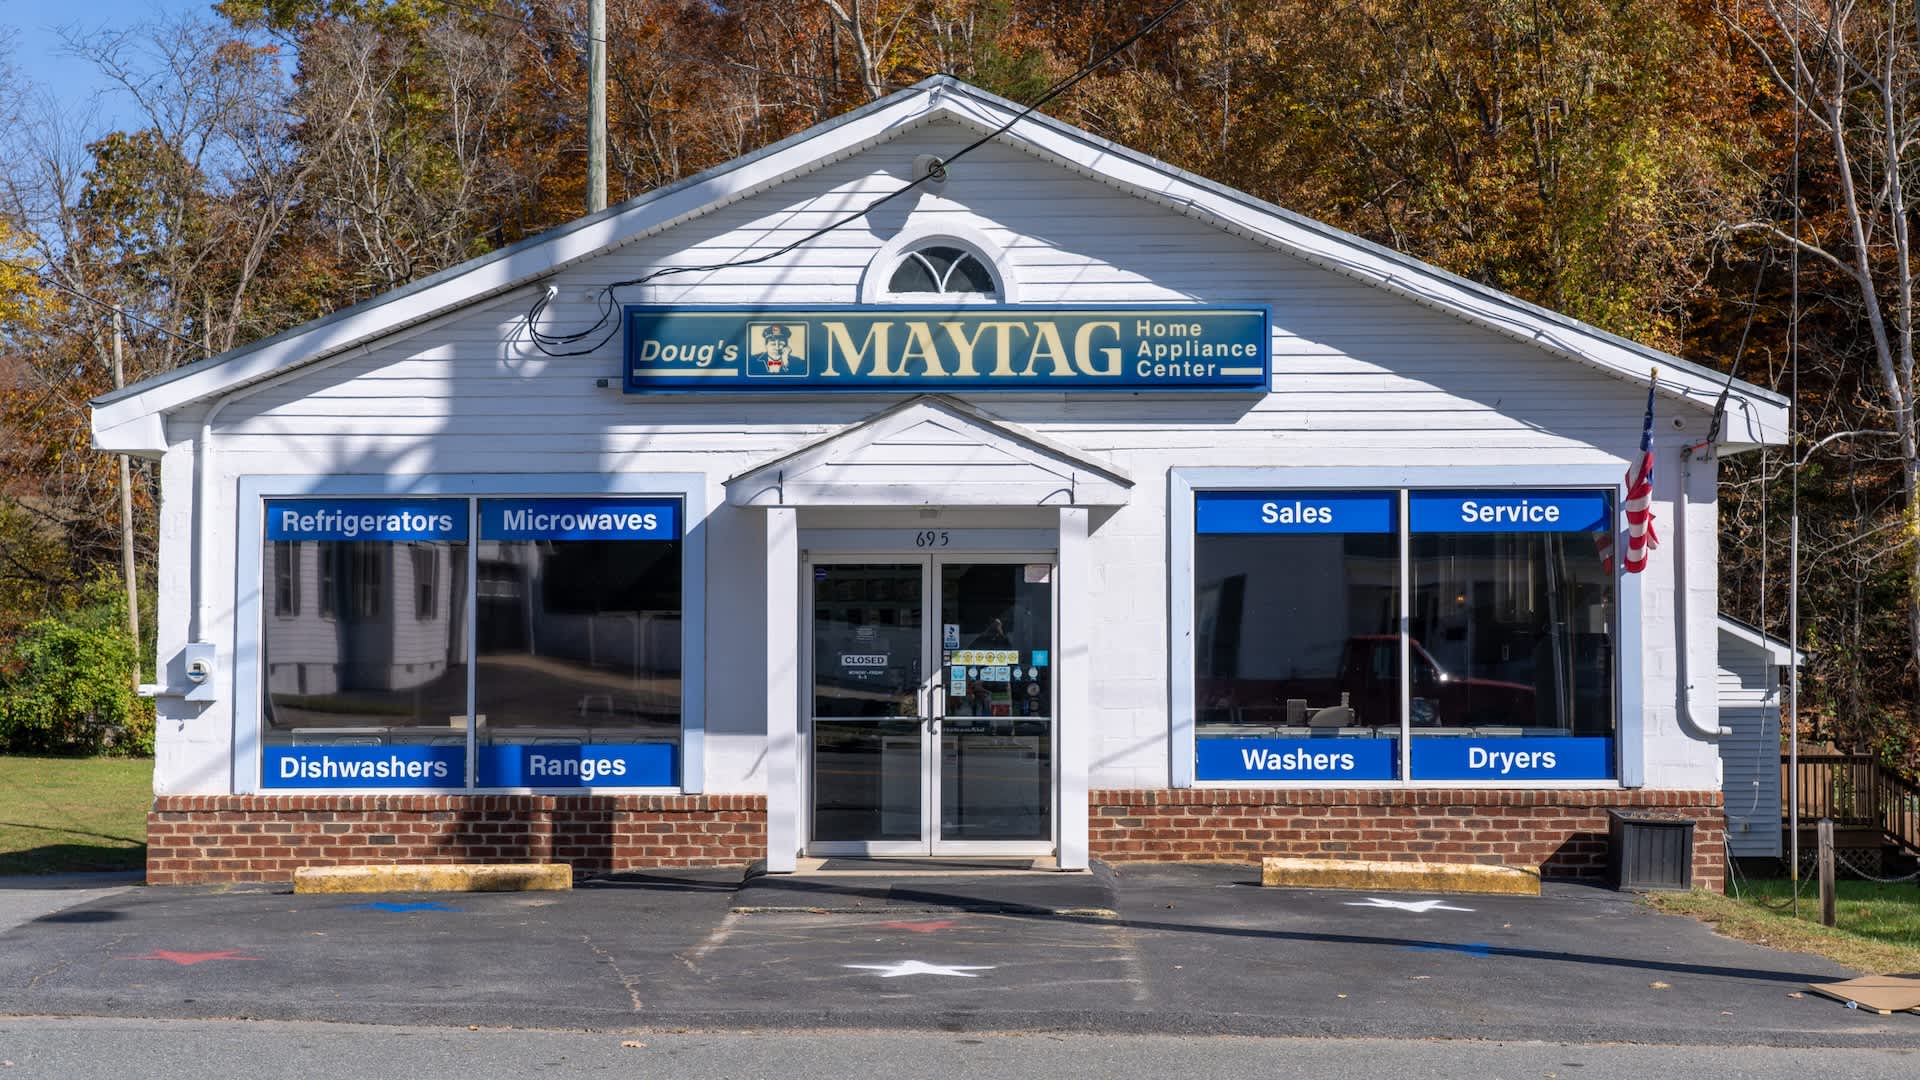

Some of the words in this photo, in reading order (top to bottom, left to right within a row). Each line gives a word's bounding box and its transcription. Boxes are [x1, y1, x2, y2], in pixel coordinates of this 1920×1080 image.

[1136, 319, 1202, 337] Home
[639, 338, 739, 368] Doug's
[819, 320, 1123, 377] MAYTAG
[1136, 339, 1258, 361] Appliance
[1136, 359, 1217, 377] Center
[502, 508, 657, 532] Microwaves
[1260, 501, 1333, 524] Sales
[1460, 499, 1560, 523] Service
[281, 510, 453, 537] Refrigerators
[916, 531, 949, 547] 695
[845, 656, 885, 664] CLOSED
[279, 755, 448, 779] Dishwashers
[529, 754, 627, 782] Ranges
[1241, 747, 1355, 771] Washers
[1468, 747, 1557, 774] Dryers
